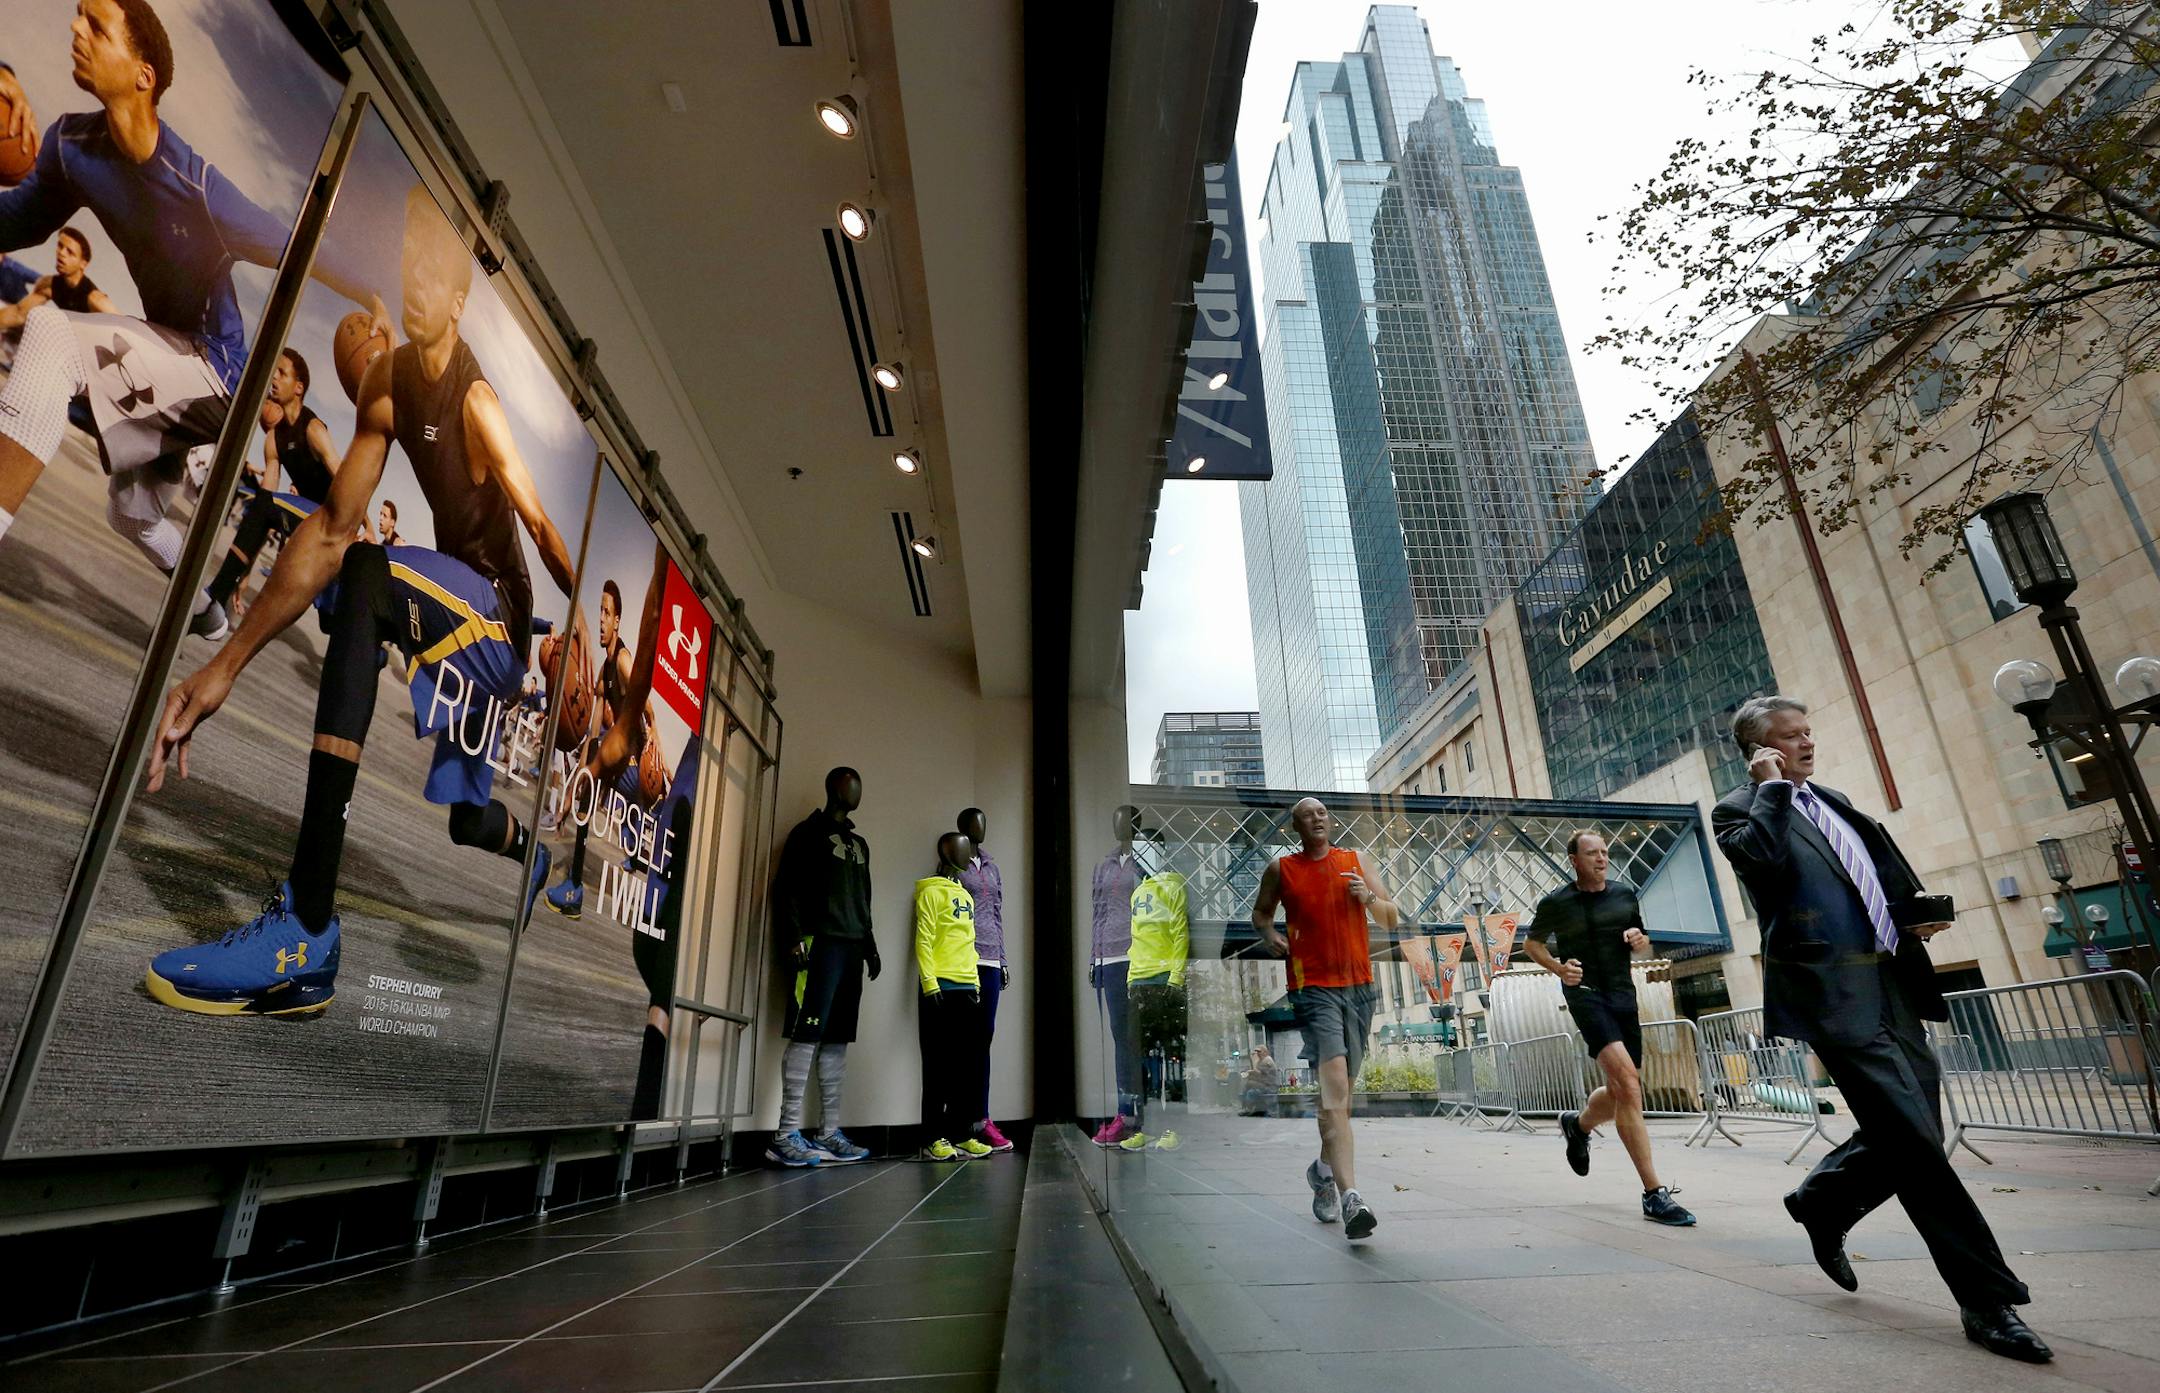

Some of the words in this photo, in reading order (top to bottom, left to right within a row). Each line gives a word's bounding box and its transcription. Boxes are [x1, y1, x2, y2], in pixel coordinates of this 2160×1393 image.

[658, 653, 678, 684] UNDER
[677, 678, 701, 710] ARMOUR
[427, 659, 538, 787] RULE
[559, 763, 676, 879] YOURSELF.
[596, 859, 609, 914] I
[611, 866, 666, 941] WILL.
[367, 974, 413, 995] STEPHEN
[412, 983, 443, 999] CURRY
[359, 1016, 393, 1033] WORLD
[393, 1020, 439, 1038] CHAMPION
[400, 1000, 414, 1015] KIA
[415, 1003, 433, 1018] NBA
